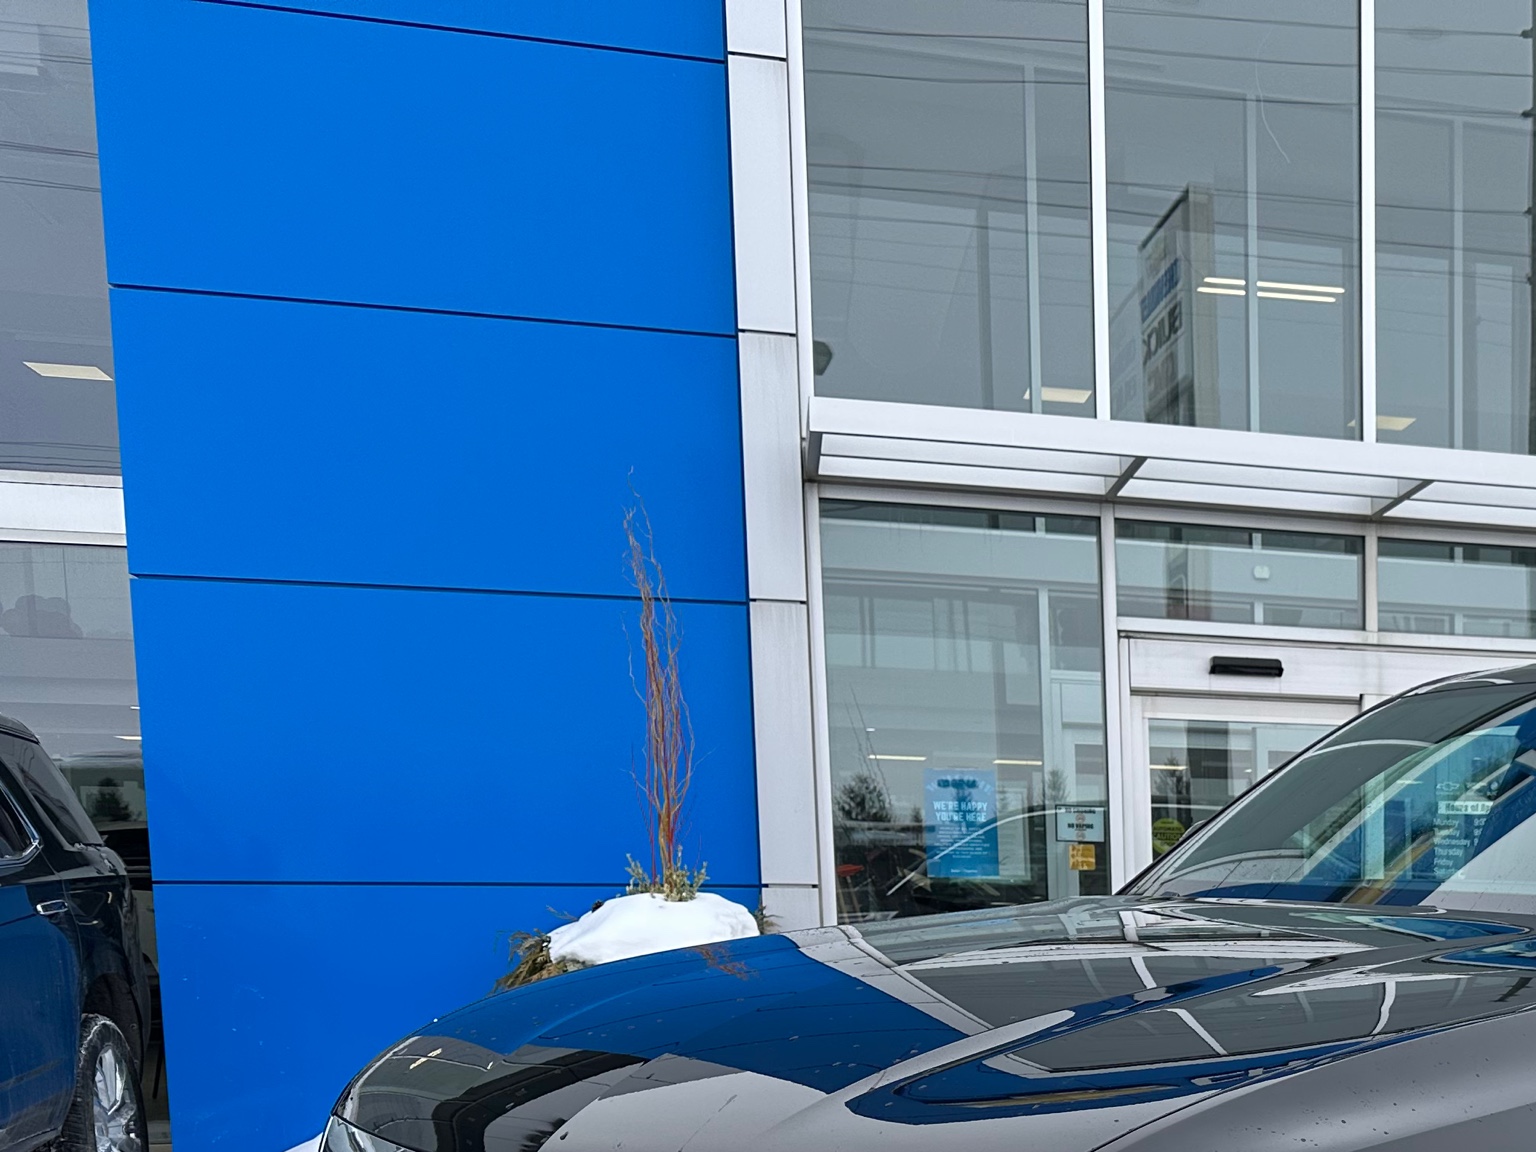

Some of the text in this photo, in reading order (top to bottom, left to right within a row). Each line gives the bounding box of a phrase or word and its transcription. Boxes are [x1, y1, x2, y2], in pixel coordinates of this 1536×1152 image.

[932, 801, 988, 812] WE'RE HAPPY
[966, 812, 987, 822] HERE
[1434, 858, 1454, 867] Friday
